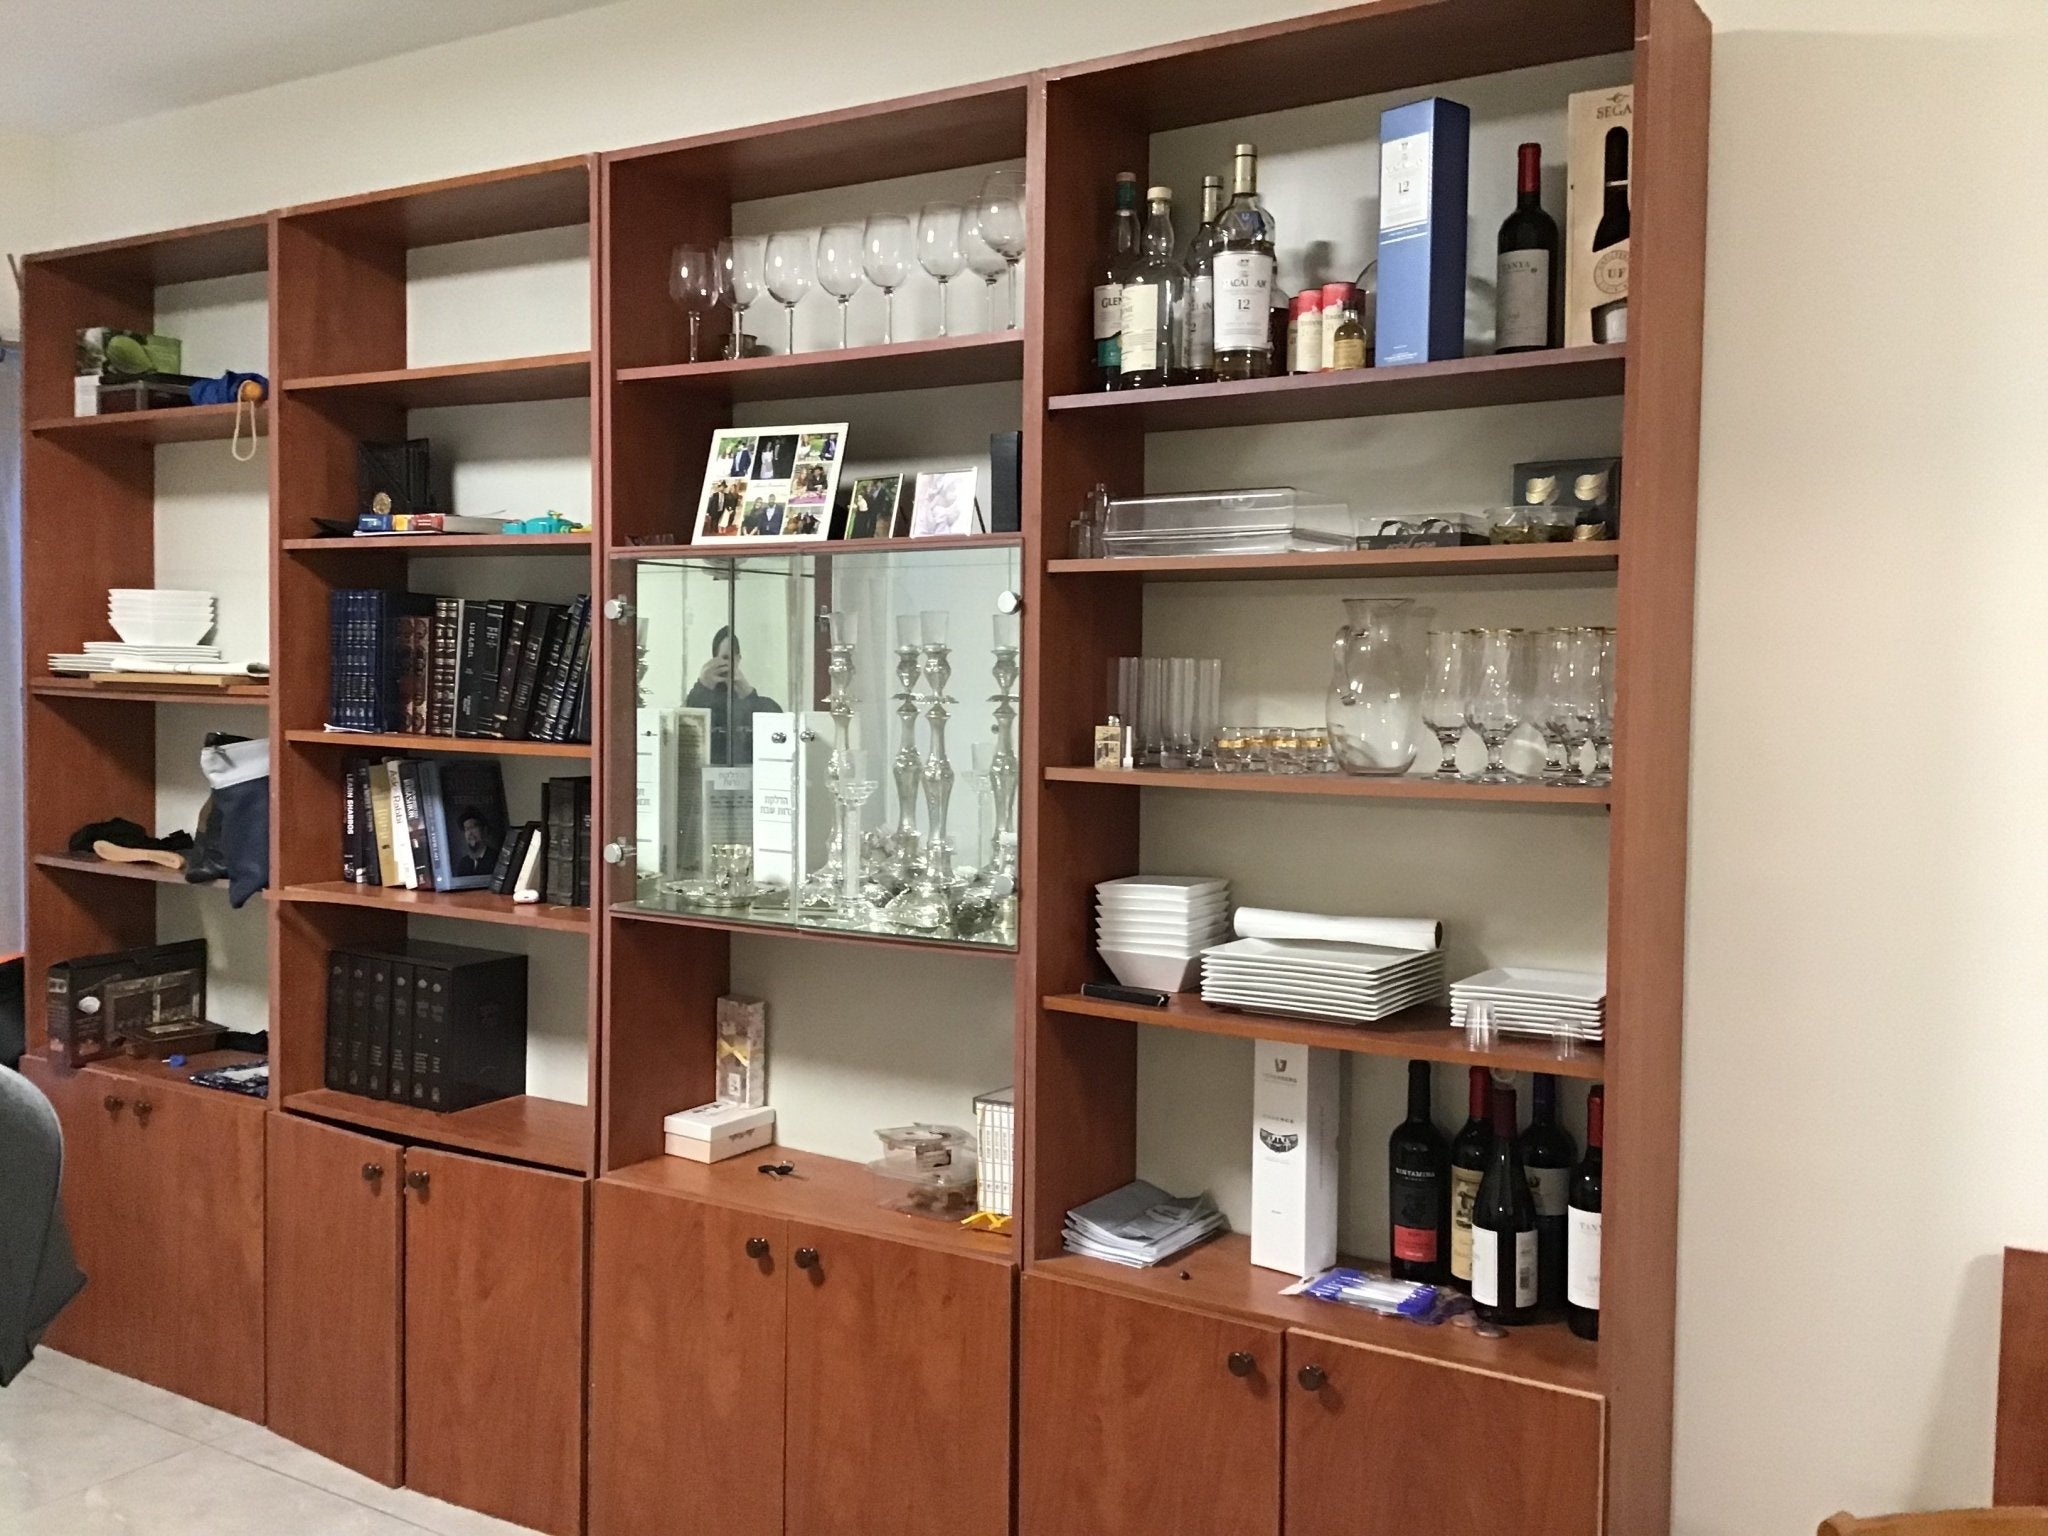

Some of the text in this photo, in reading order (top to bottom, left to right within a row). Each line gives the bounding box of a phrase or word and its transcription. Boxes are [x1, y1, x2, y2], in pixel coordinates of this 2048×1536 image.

[1596, 103, 1632, 120] SEGA
[1397, 180, 1410, 194] 12
[1237, 299, 1251, 311] 12
[346, 773, 354, 835] LEARN SHABBOS
[392, 795, 403, 824] Rabbi
